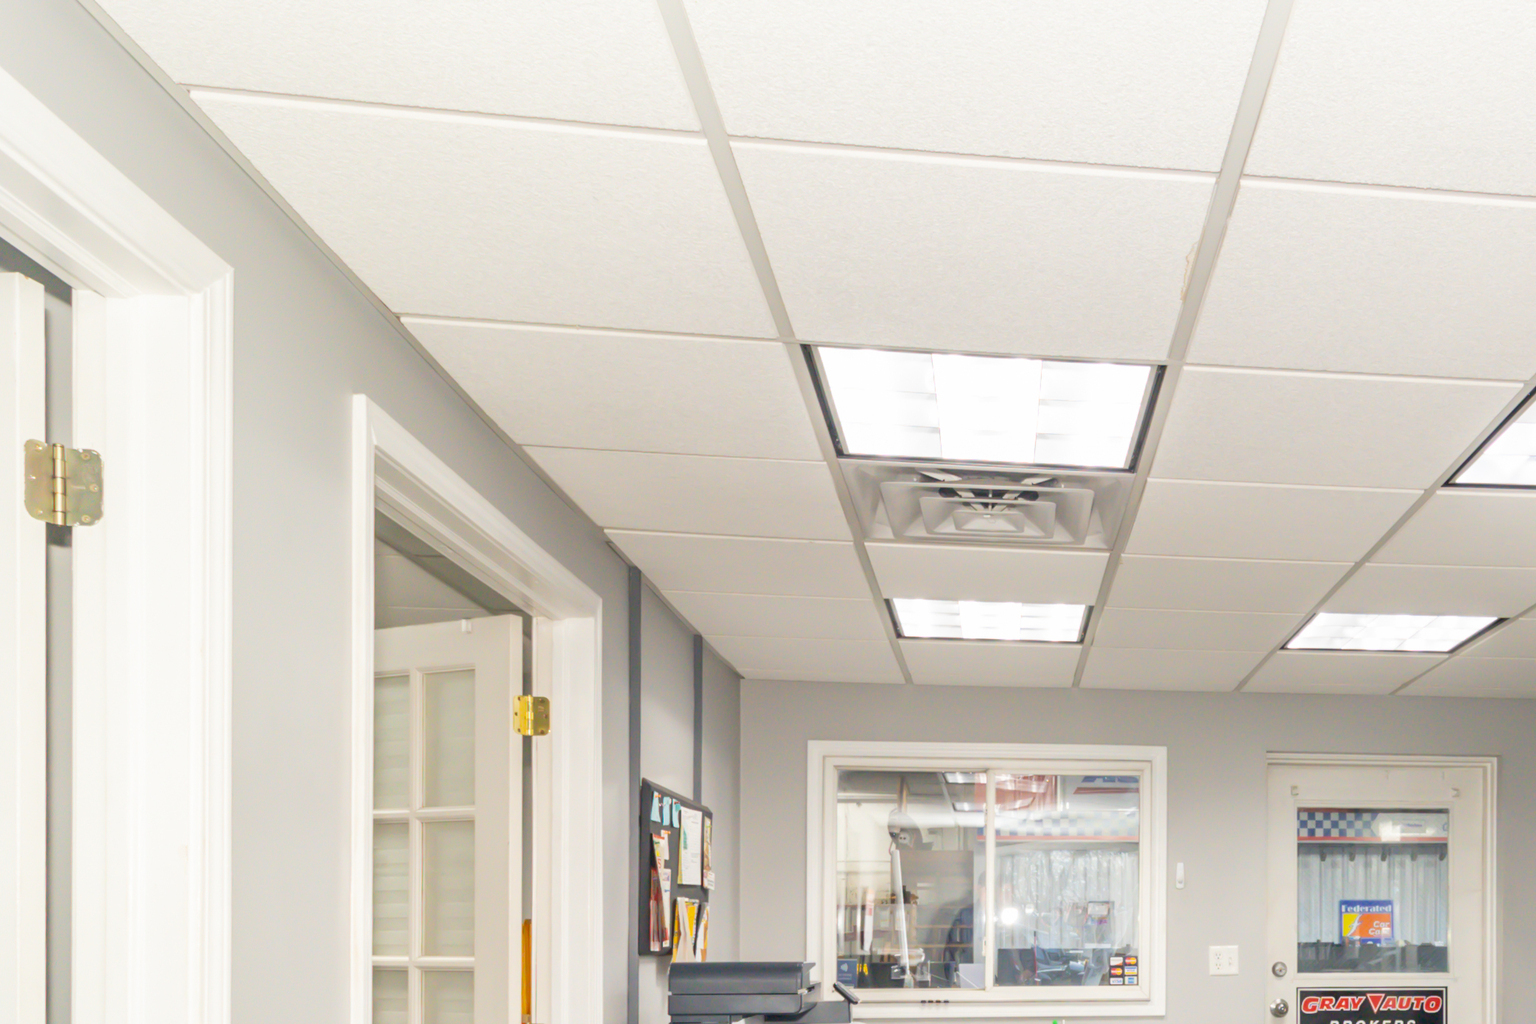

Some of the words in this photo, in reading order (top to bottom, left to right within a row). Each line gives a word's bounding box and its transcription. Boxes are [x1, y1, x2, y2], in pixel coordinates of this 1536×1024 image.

[1341, 904, 1392, 913] Federated
[1373, 920, 1390, 928] Car
[1301, 996, 1366, 1014] GRAY
[1380, 996, 1443, 1013] AUTO
